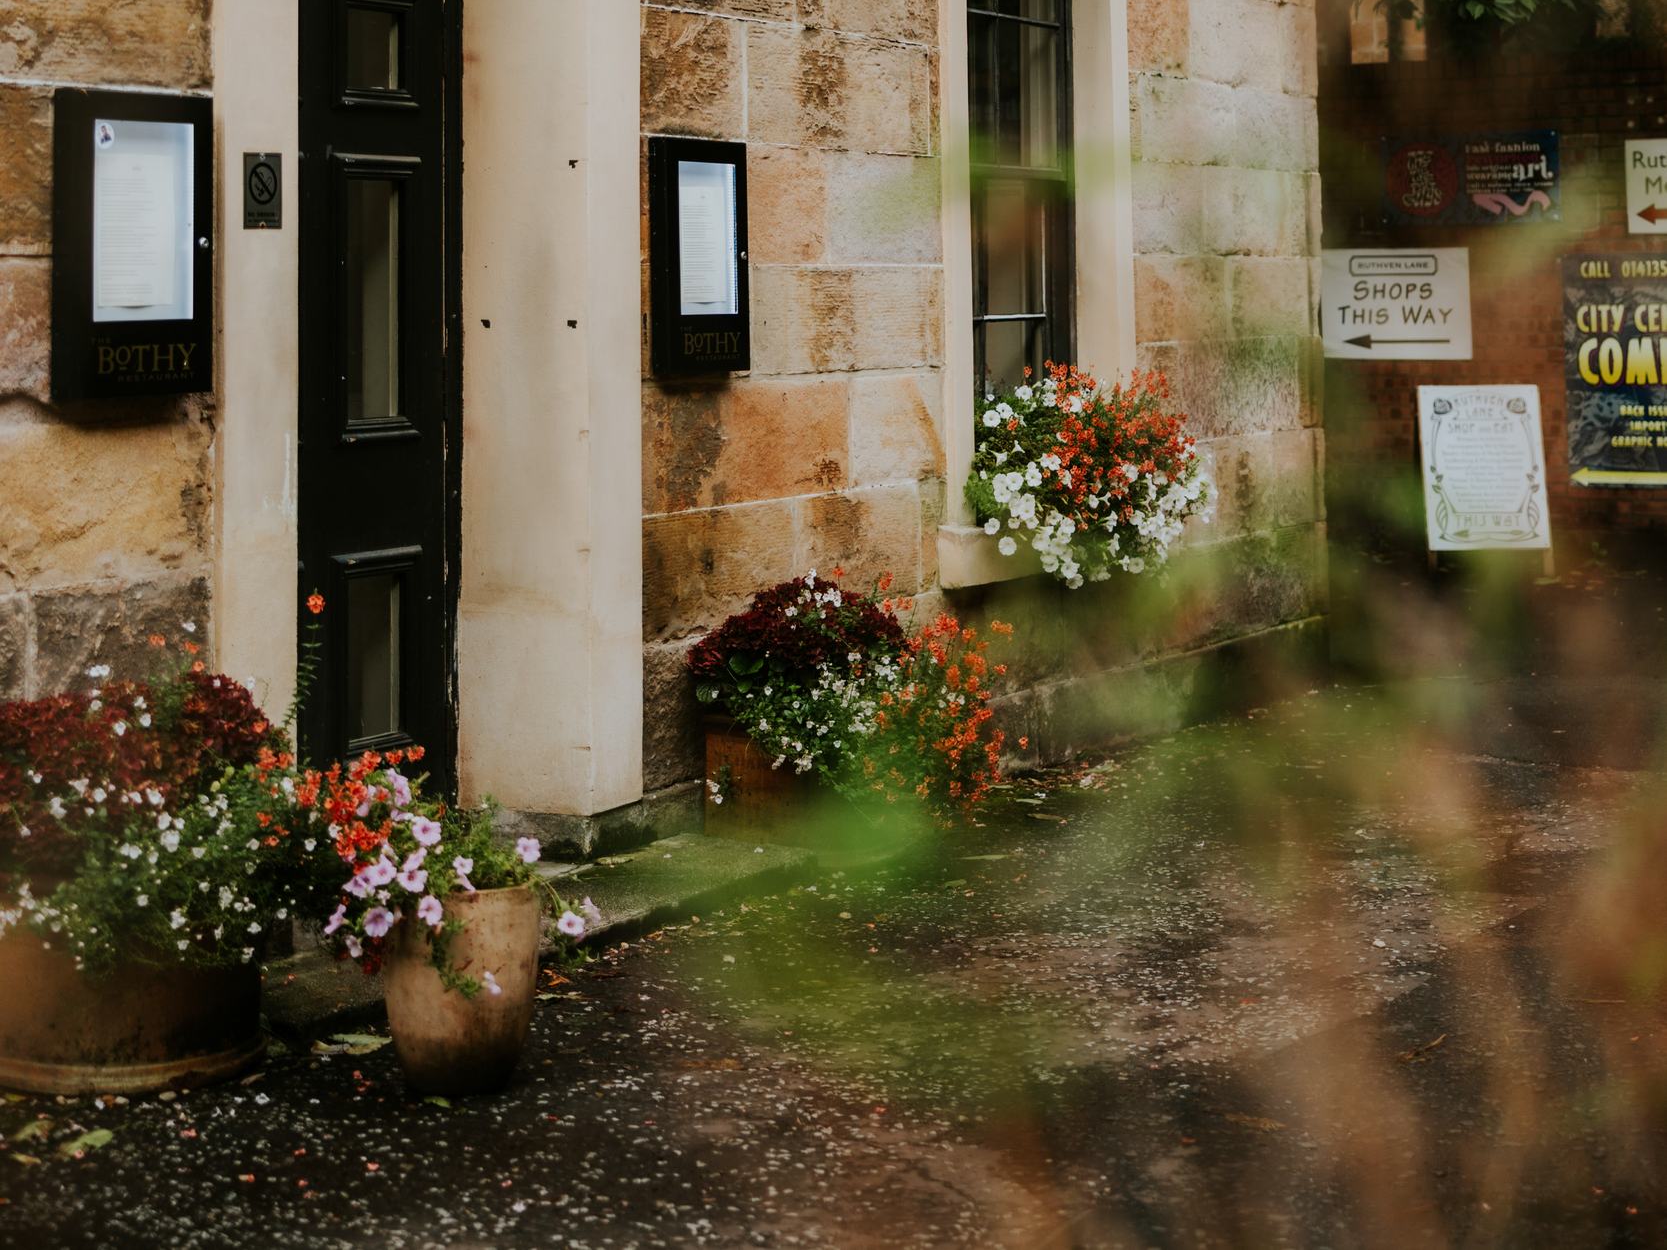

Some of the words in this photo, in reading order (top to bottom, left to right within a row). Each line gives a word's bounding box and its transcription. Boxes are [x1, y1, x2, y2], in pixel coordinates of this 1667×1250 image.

[1645, 175, 1667, 195] M
[1357, 261, 1402, 269] RUTHVEN
[1404, 261, 1429, 269] LANE
[1580, 260, 1611, 278] CALL
[1353, 280, 1433, 301] SHOPS
[1338, 305, 1390, 325] THIS
[1401, 305, 1453, 325] WAY
[1576, 304, 1625, 333] CITY
